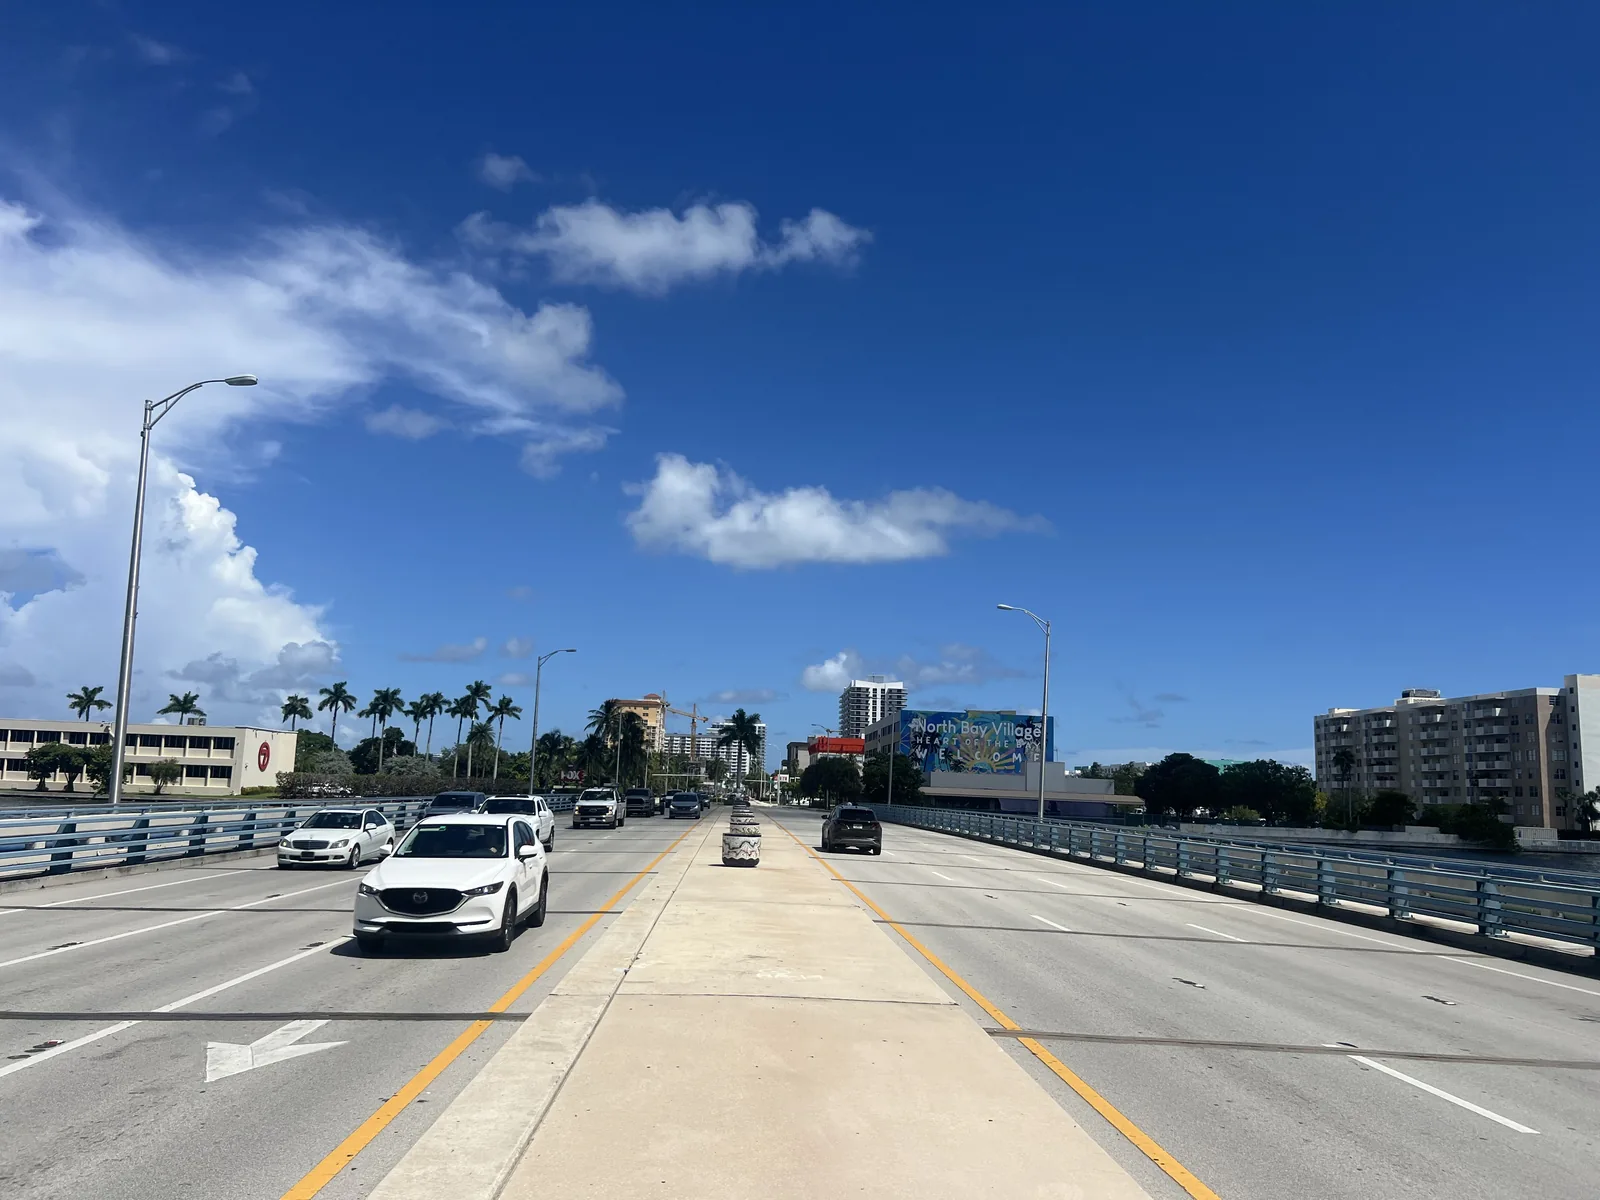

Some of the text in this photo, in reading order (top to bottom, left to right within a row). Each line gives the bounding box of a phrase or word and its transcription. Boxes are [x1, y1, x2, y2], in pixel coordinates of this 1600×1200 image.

[914, 718, 1042, 740] North Bay Village
[916, 736, 1041, 749] HEART OF THE BAY
